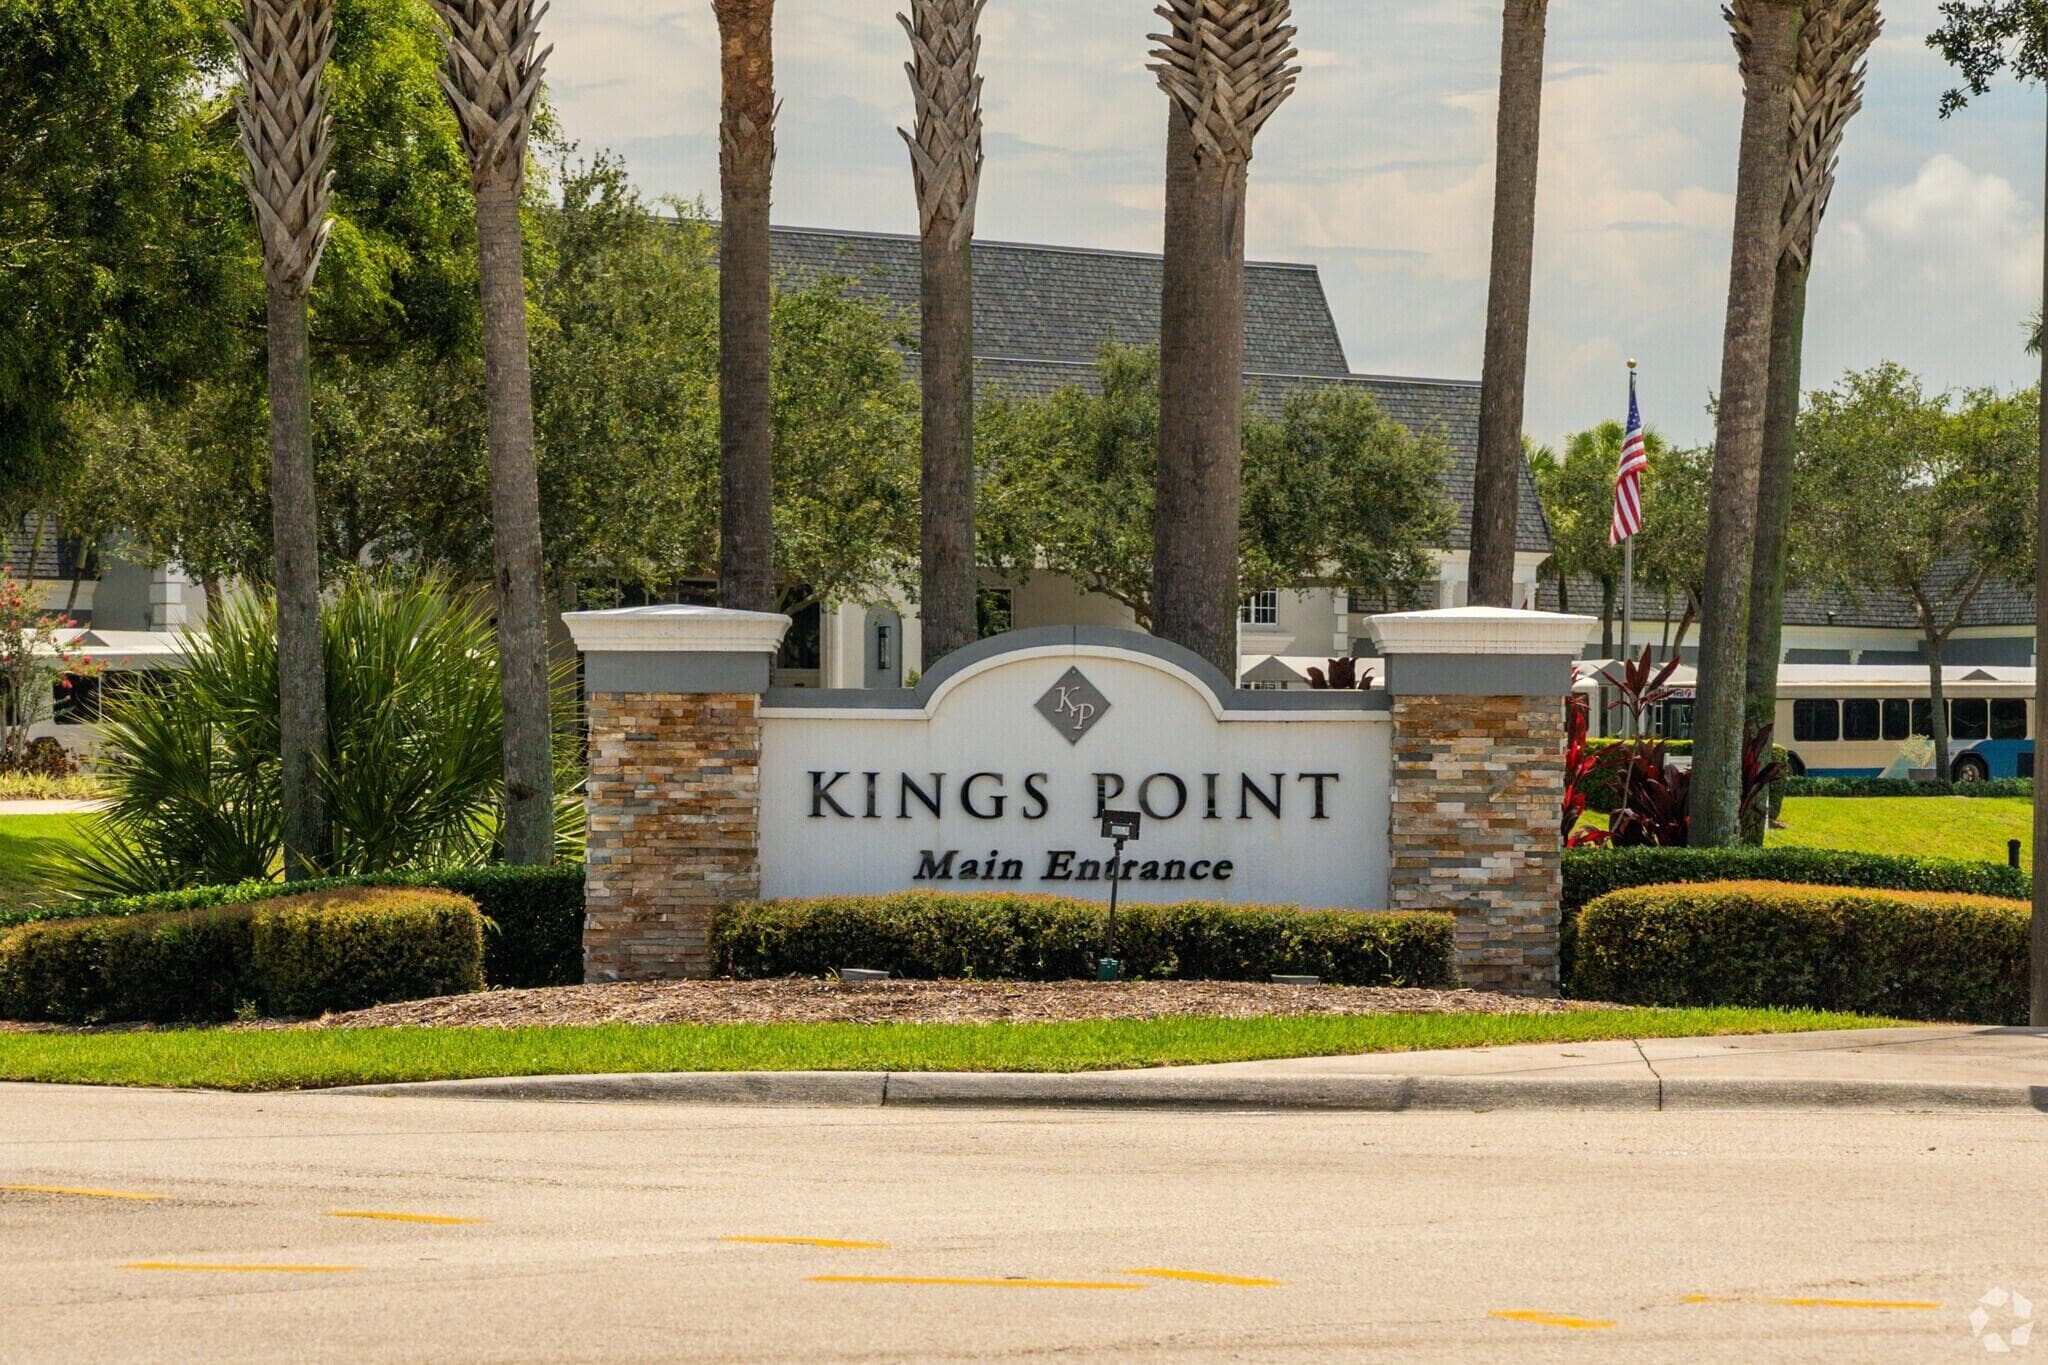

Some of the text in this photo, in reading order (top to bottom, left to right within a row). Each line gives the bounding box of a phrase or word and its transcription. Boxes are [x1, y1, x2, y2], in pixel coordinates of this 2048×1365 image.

[807, 771, 1340, 820] KINGS POINT
[913, 850, 1234, 881] Main Entrance
